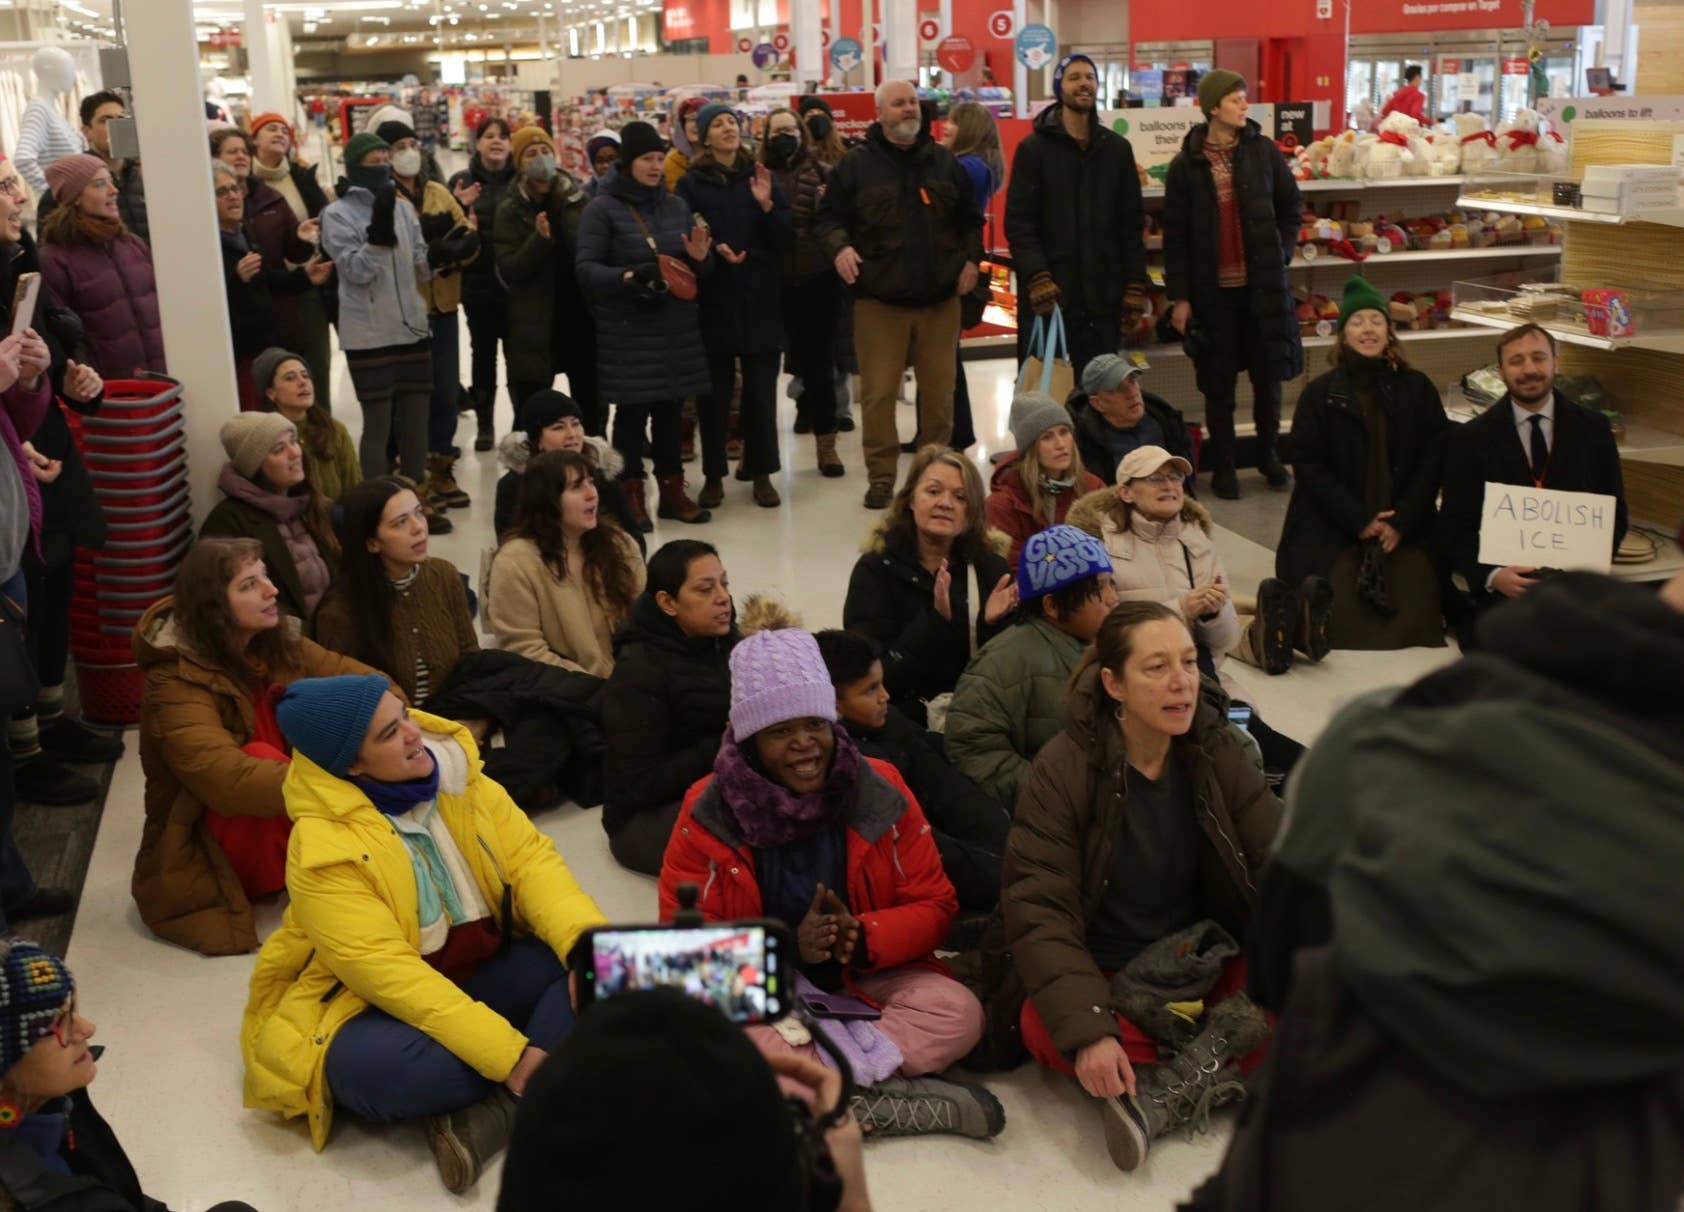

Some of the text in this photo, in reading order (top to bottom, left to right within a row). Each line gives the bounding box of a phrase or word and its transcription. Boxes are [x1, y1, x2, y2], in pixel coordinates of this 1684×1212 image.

[997, 19, 1007, 31] 5
[1281, 110, 1305, 119] new
[1585, 108, 1626, 119] balloons
[1628, 109, 1638, 118] to
[1139, 120, 1186, 132] balloons
[1281, 121, 1293, 132] at
[1155, 134, 1180, 146] their
[1493, 493, 1604, 529] ABOLISH
[1519, 529, 1569, 551] ICE
